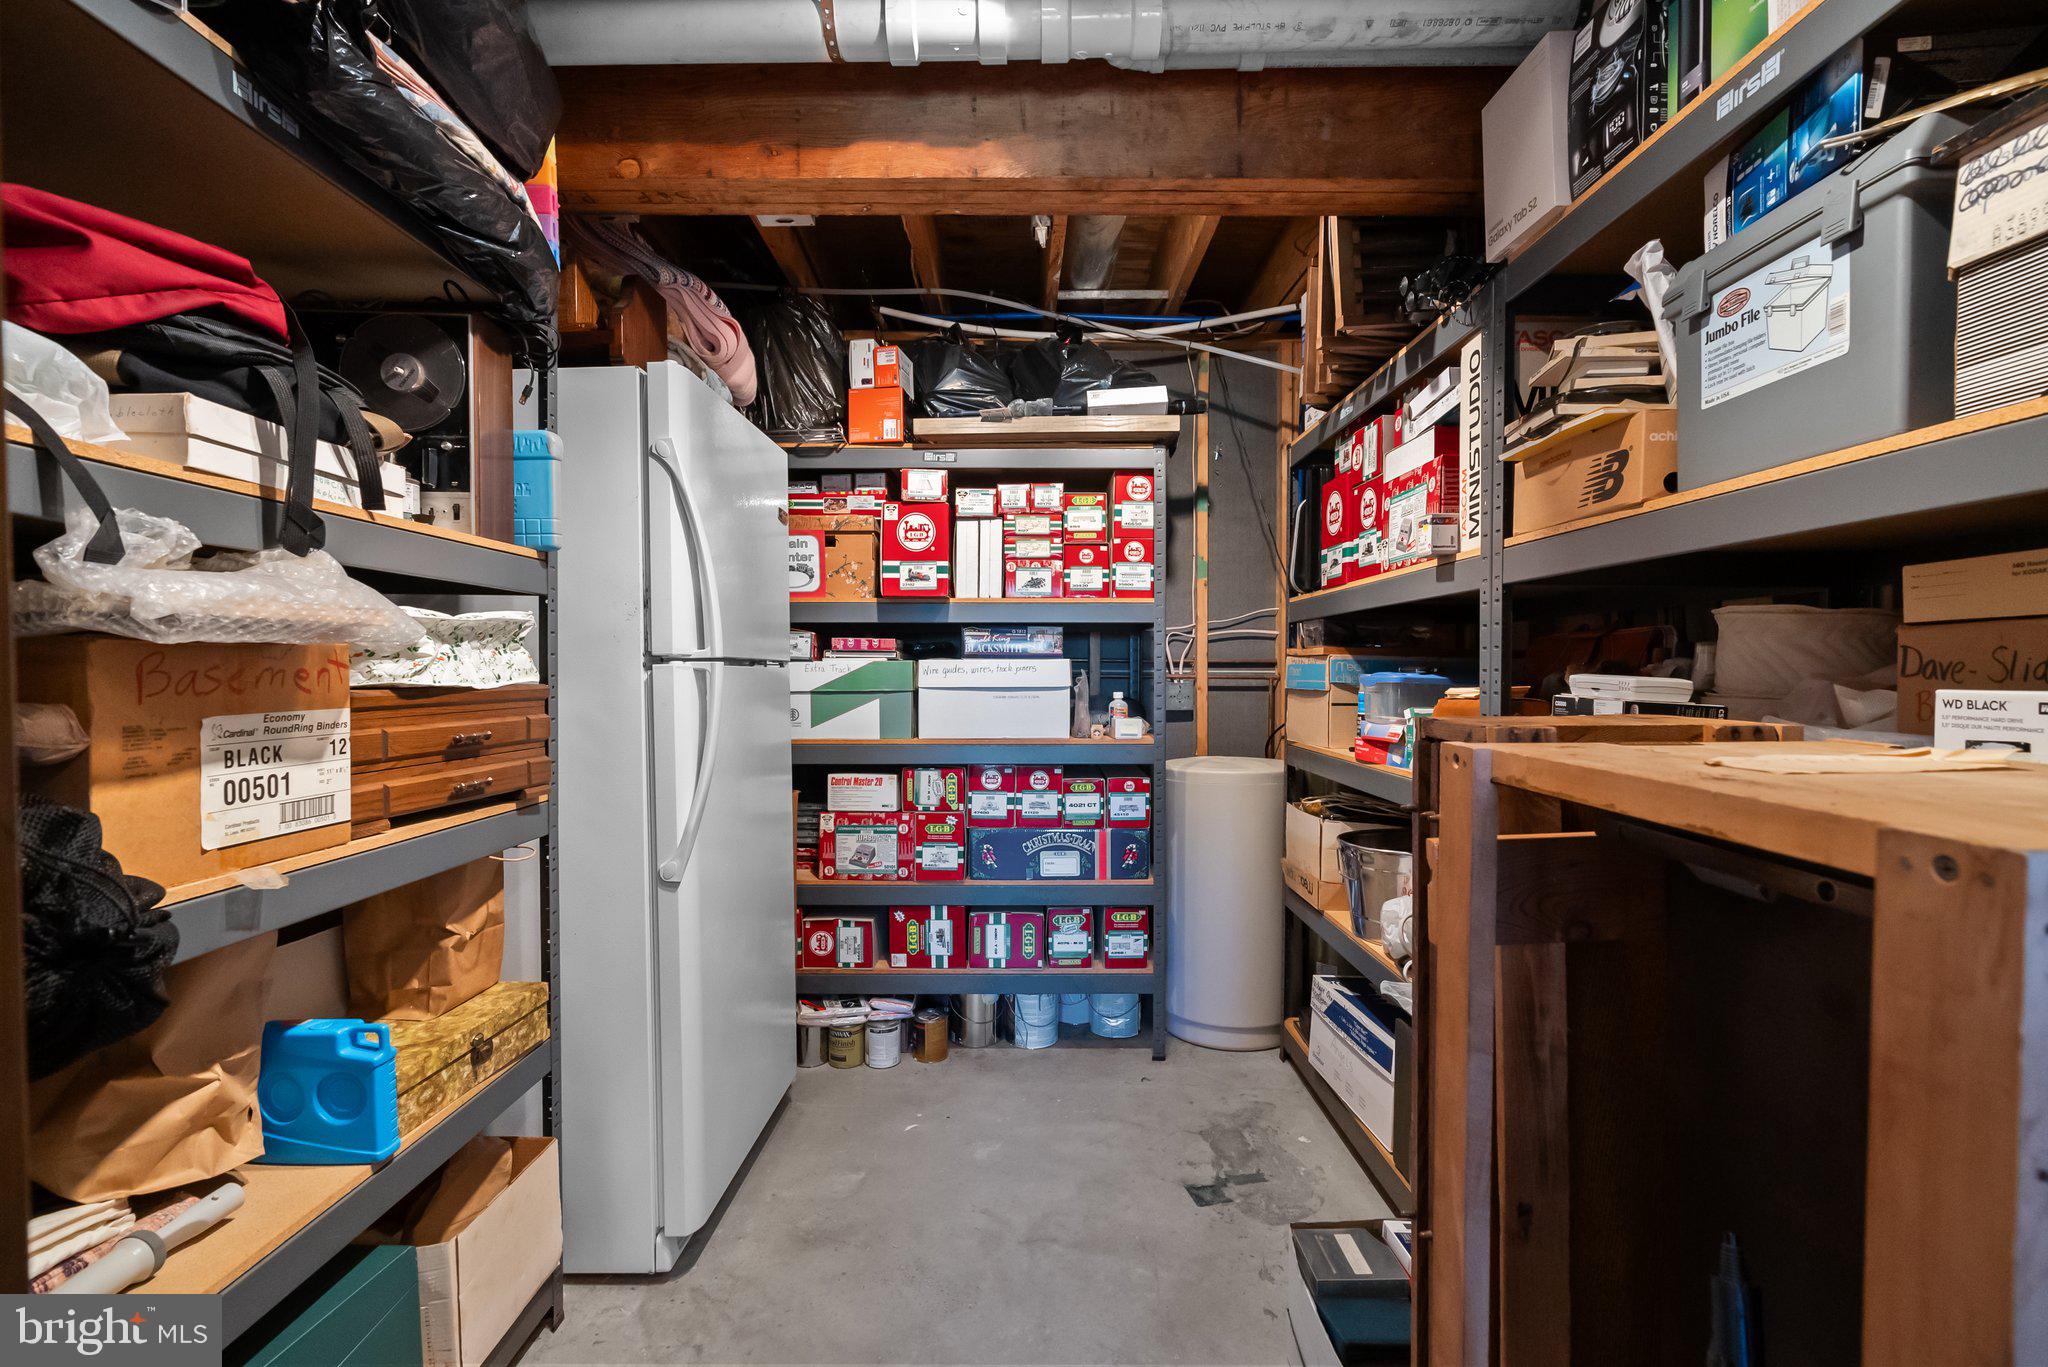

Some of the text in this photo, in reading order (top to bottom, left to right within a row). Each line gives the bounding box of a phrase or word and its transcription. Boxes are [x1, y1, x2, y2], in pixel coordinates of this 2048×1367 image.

[1488, 220, 1512, 246] Galaxy
[1513, 207, 1528, 224] Tab
[1528, 196, 1538, 212] S2
[1704, 308, 1760, 346] Jumbo File
[1468, 350, 1480, 540] MINISTUDIO
[789, 538, 808, 549] ain
[788, 552, 814, 562] nter
[992, 634, 1011, 644] King
[965, 644, 1024, 653] BLACKSMITH
[804, 664, 852, 673] Extra Track
[922, 665, 939, 676] Wire
[135, 647, 350, 706] Basement
[1942, 698, 2008, 712] WD BLACK
[263, 714, 306, 724] Economy
[263, 721, 348, 735] RoundRing Binders
[222, 730, 256, 739] Cardinal
[224, 738, 347, 769] BLACK 12
[830, 776, 883, 787] Control Master 20
[223, 772, 290, 806] 00501
[242, 819, 260, 828] Products
[1117, 913, 1137, 921] LGB
[909, 925, 917, 950] LGB
